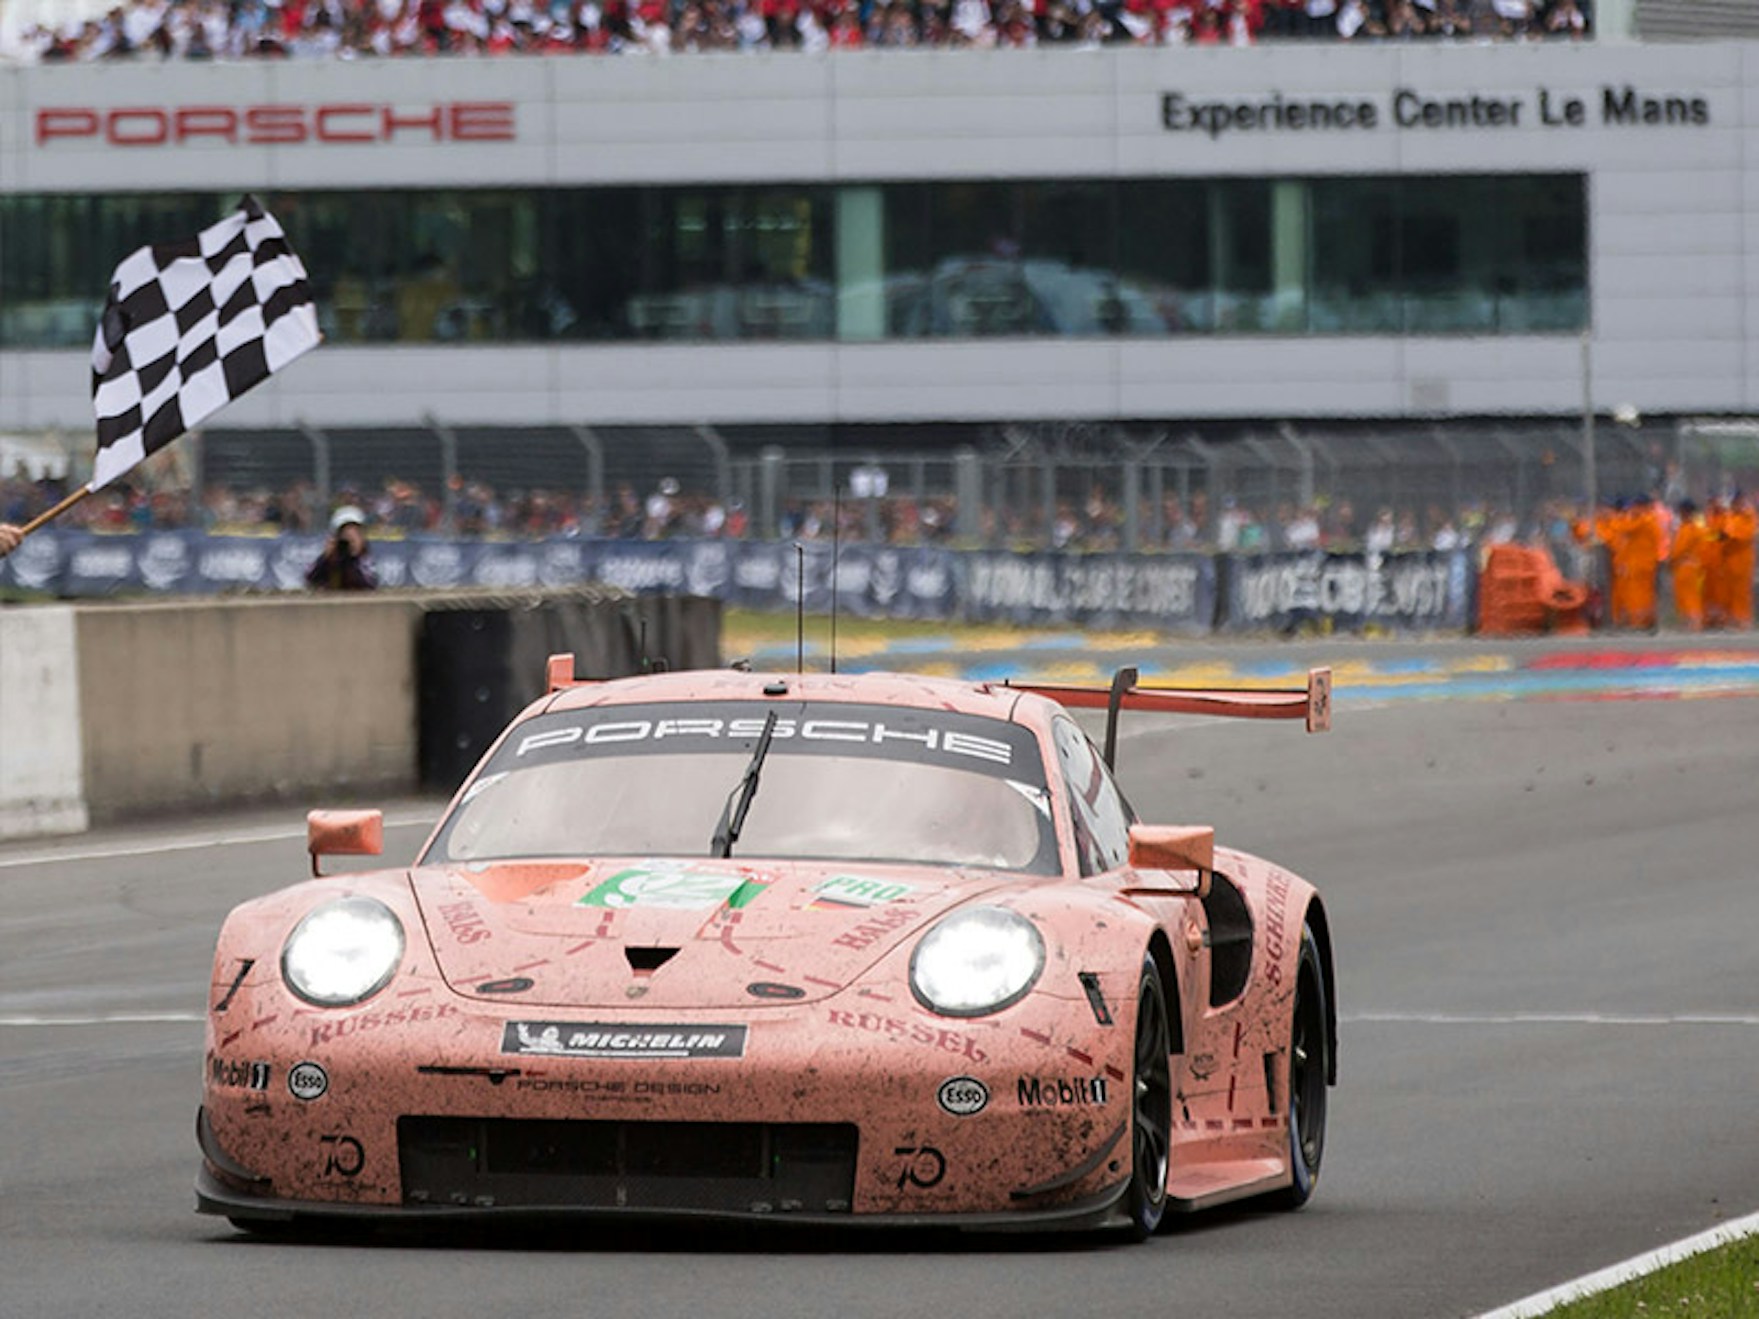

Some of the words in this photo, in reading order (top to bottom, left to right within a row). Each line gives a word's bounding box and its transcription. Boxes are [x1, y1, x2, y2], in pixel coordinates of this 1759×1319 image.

[37, 102, 516, 145] PORSCHE
[1161, 92, 1378, 138] Experience
[1394, 89, 1524, 128] Center
[1538, 89, 1585, 126] Le
[1603, 86, 1711, 125] Mans
[518, 719, 1013, 765] PORSCHE
[823, 876, 908, 901] PRO
[569, 1032, 726, 1049] MICHELIN
[516, 1079, 626, 1093] PORSCHE
[634, 1081, 721, 1095] DESIGN
[321, 1135, 365, 1176] 70
[895, 1147, 946, 1191] 70
